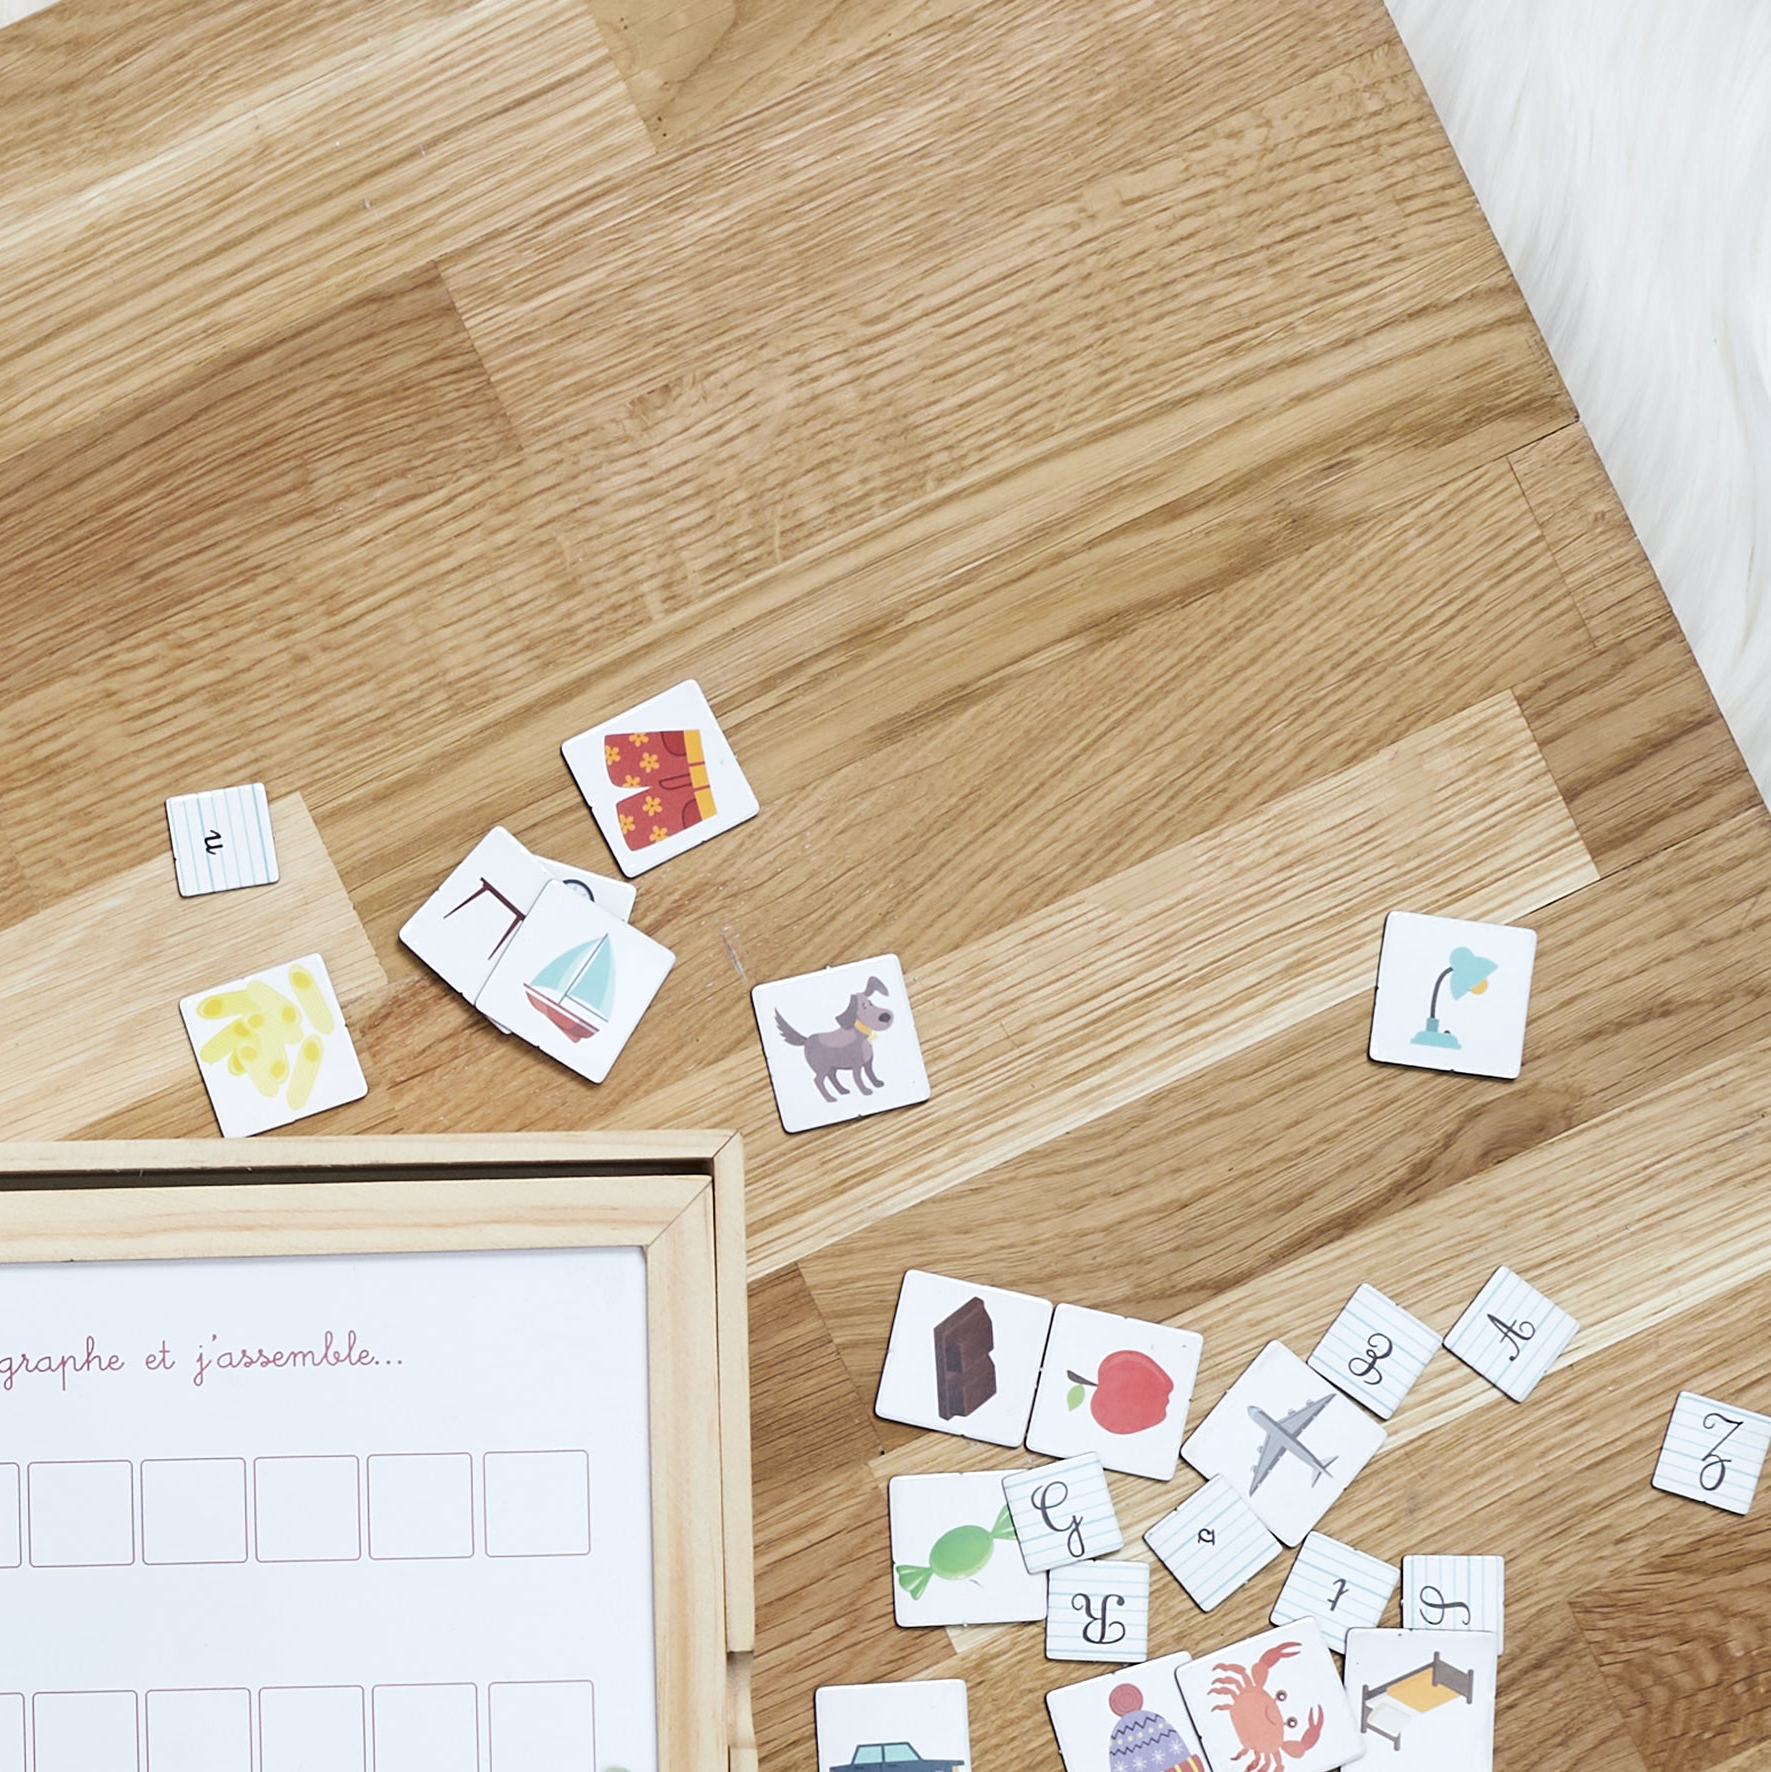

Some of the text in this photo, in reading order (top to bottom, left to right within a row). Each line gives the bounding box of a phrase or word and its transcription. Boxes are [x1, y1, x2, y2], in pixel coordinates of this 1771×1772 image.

[145, 1340, 176, 1370] et
[193, 1330, 403, 1386] j'assemble...
[1348, 1332, 1394, 1386] E
[1498, 1313, 1536, 1362] A
[1699, 1412, 1744, 1492] Z
[1031, 1483, 1086, 1557] G
[1071, 1592, 1126, 1645] R
[1327, 1578, 1349, 1612] t
